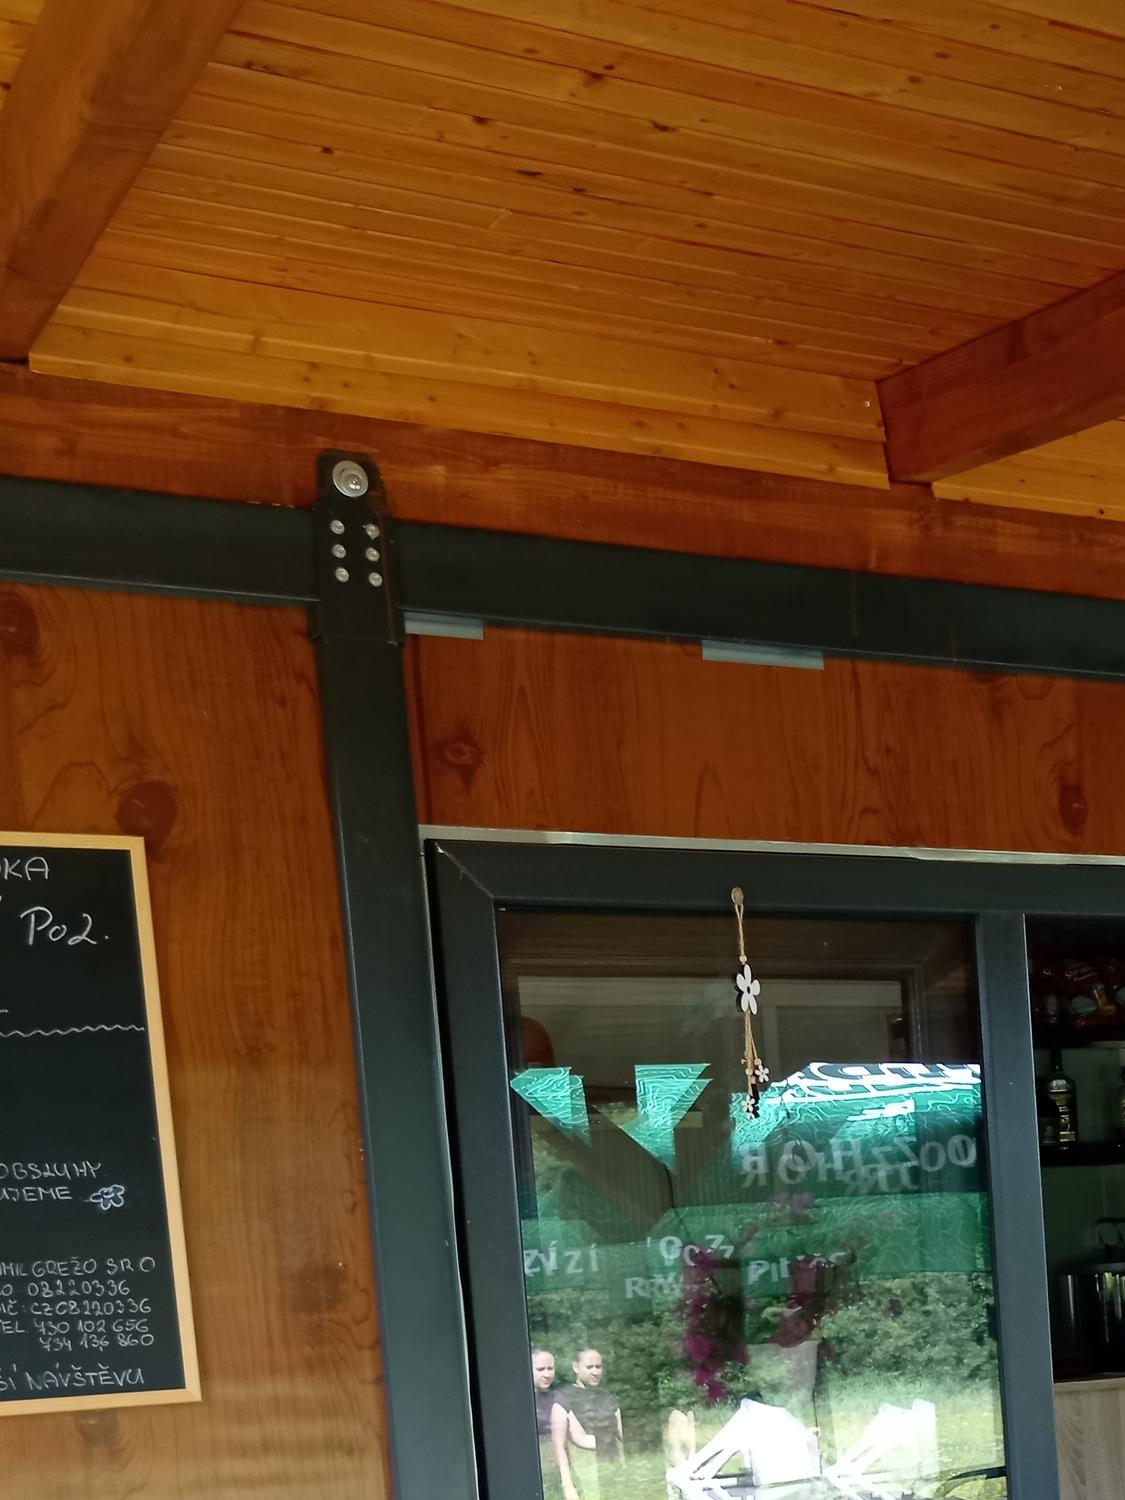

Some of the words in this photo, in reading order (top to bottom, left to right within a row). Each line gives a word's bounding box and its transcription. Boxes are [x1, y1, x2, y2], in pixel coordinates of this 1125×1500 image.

[0, 856, 50, 881] KA
[0, 1261, 28, 1276] MIL
[112, 1318, 150, 1333] 656
[117, 1332, 155, 1348] 860
